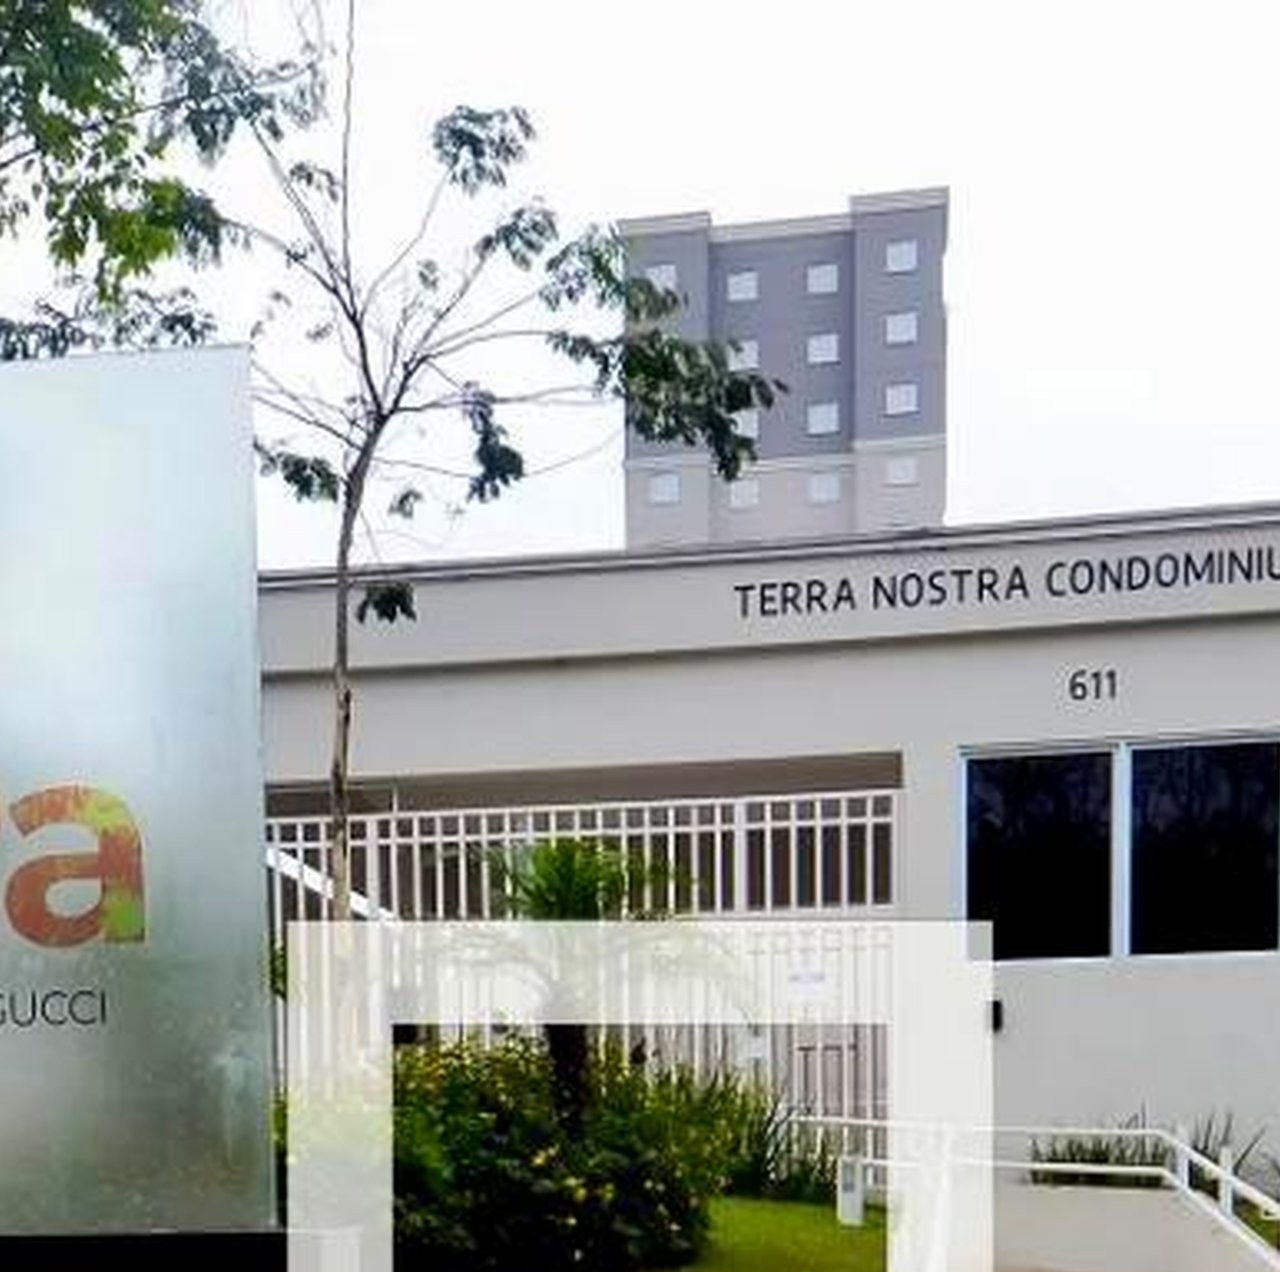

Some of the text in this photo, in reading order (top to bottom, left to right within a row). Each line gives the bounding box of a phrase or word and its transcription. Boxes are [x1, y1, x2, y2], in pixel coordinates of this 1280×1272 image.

[734, 577, 857, 618] TERRA
[872, 565, 1030, 608] NOSTRA
[1068, 669, 1118, 701] 611
